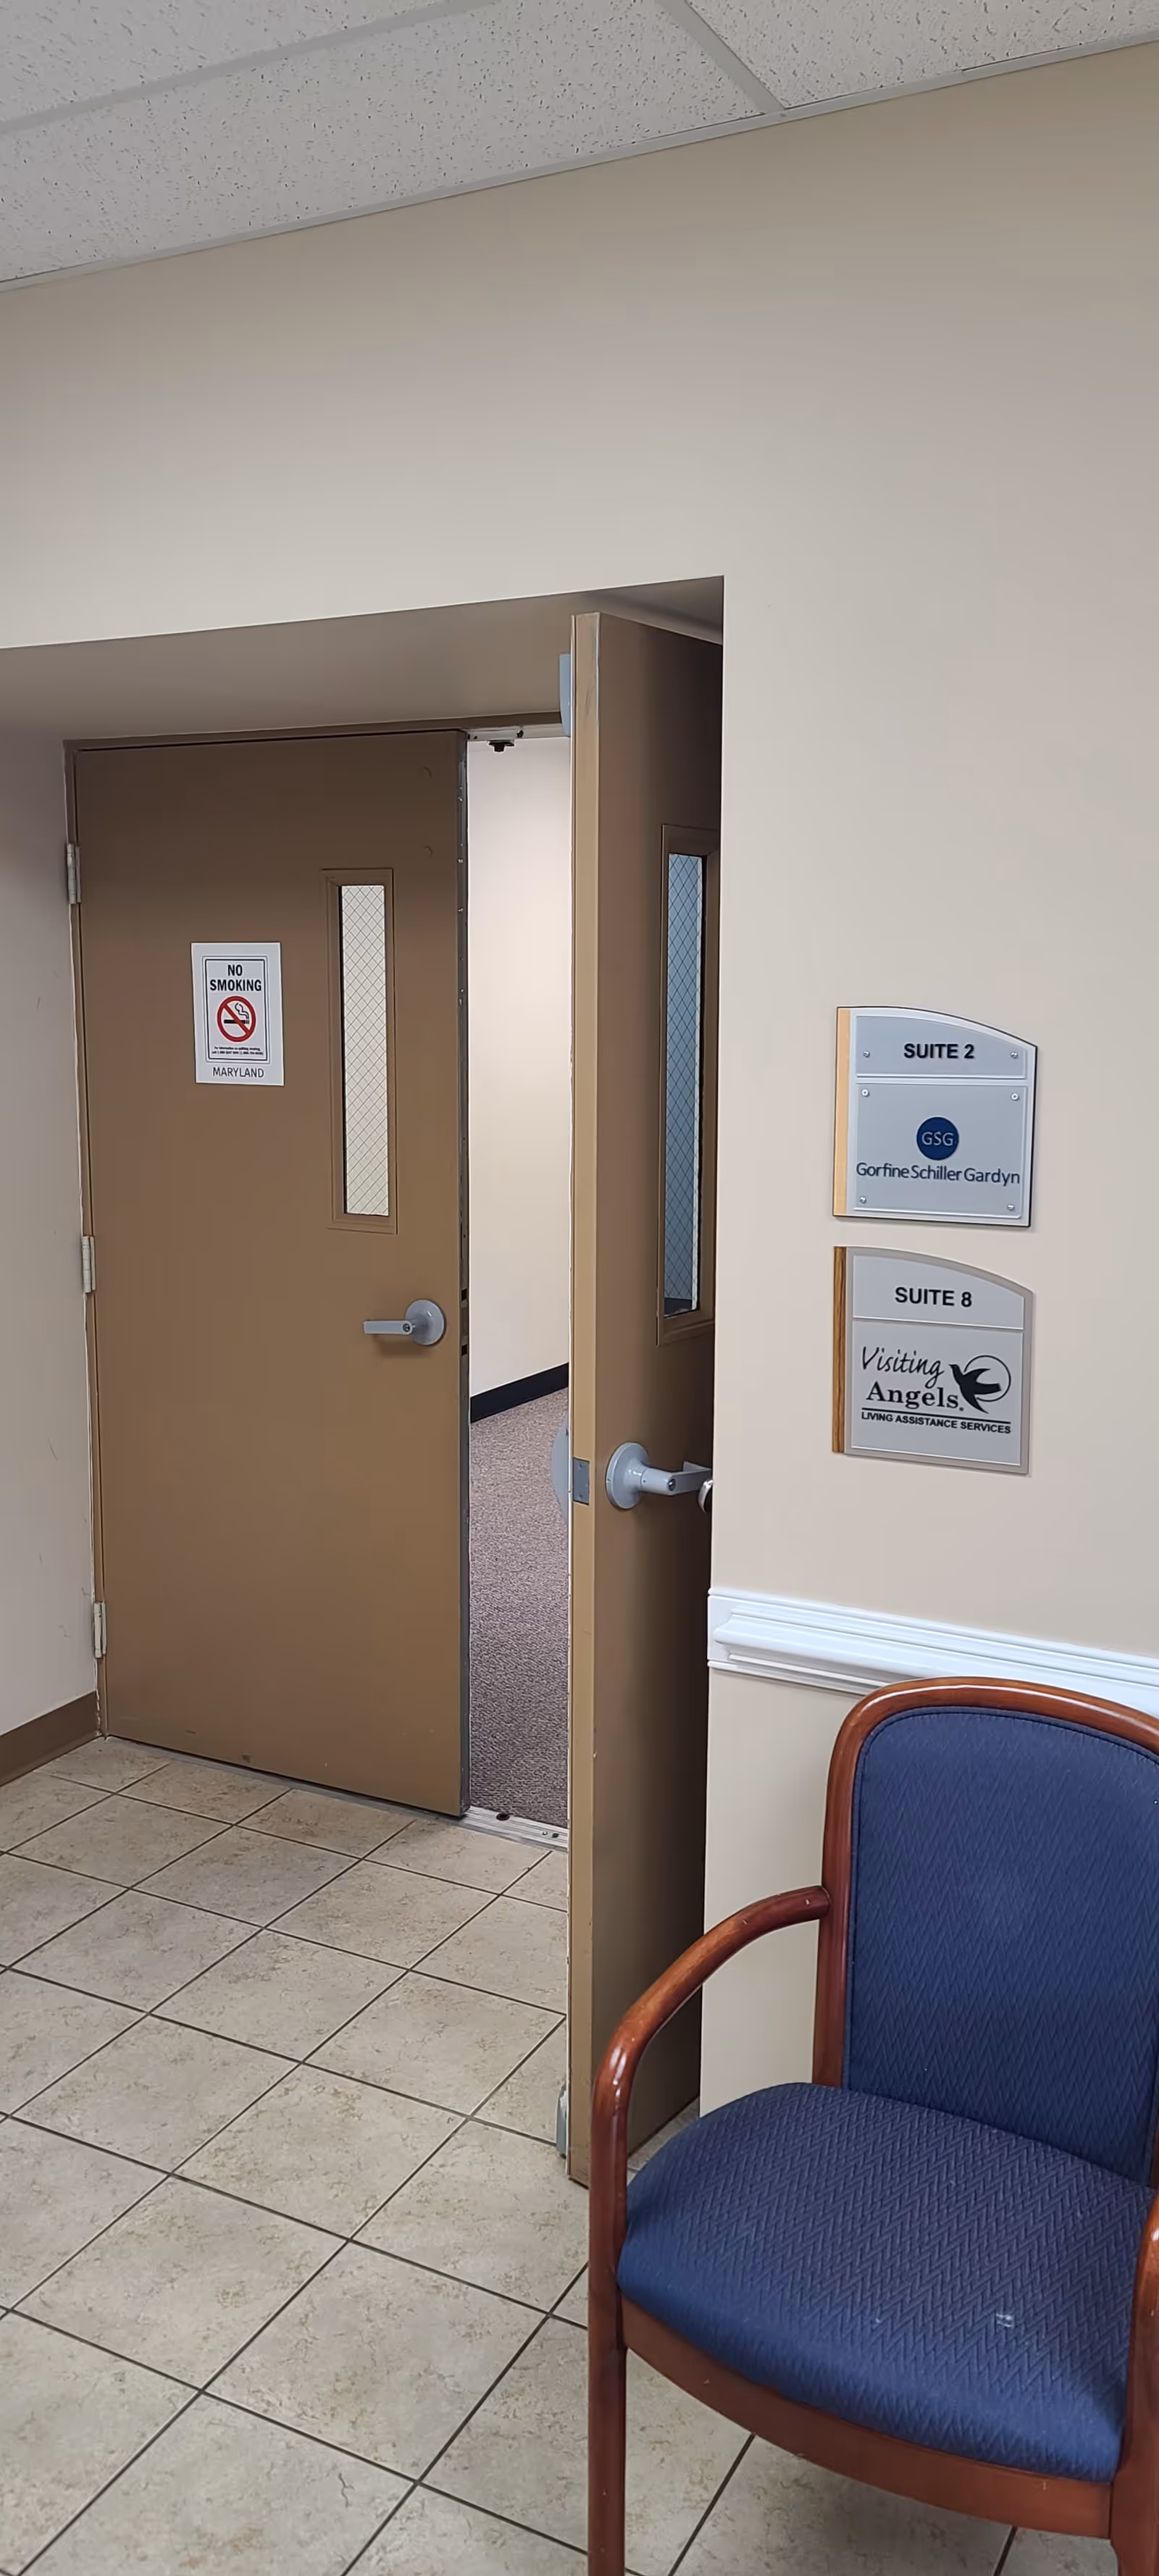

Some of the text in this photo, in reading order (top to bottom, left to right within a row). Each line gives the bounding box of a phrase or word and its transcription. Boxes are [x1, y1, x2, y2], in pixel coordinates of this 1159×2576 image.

[227, 964, 243, 977] NO
[209, 979, 262, 992] SMOKING
[903, 1043, 975, 1059] SUITE 2
[213, 1067, 264, 1078] MARYLAND
[921, 1132, 953, 1146] GSG
[856, 1162, 1020, 1187] Gorfine Schiller Gardyn
[895, 1287, 972, 1308] SUITE 8
[862, 1346, 945, 1389] Visiting
[861, 1412, 1011, 1434] LIVING ASSISTANCE SERVICES
